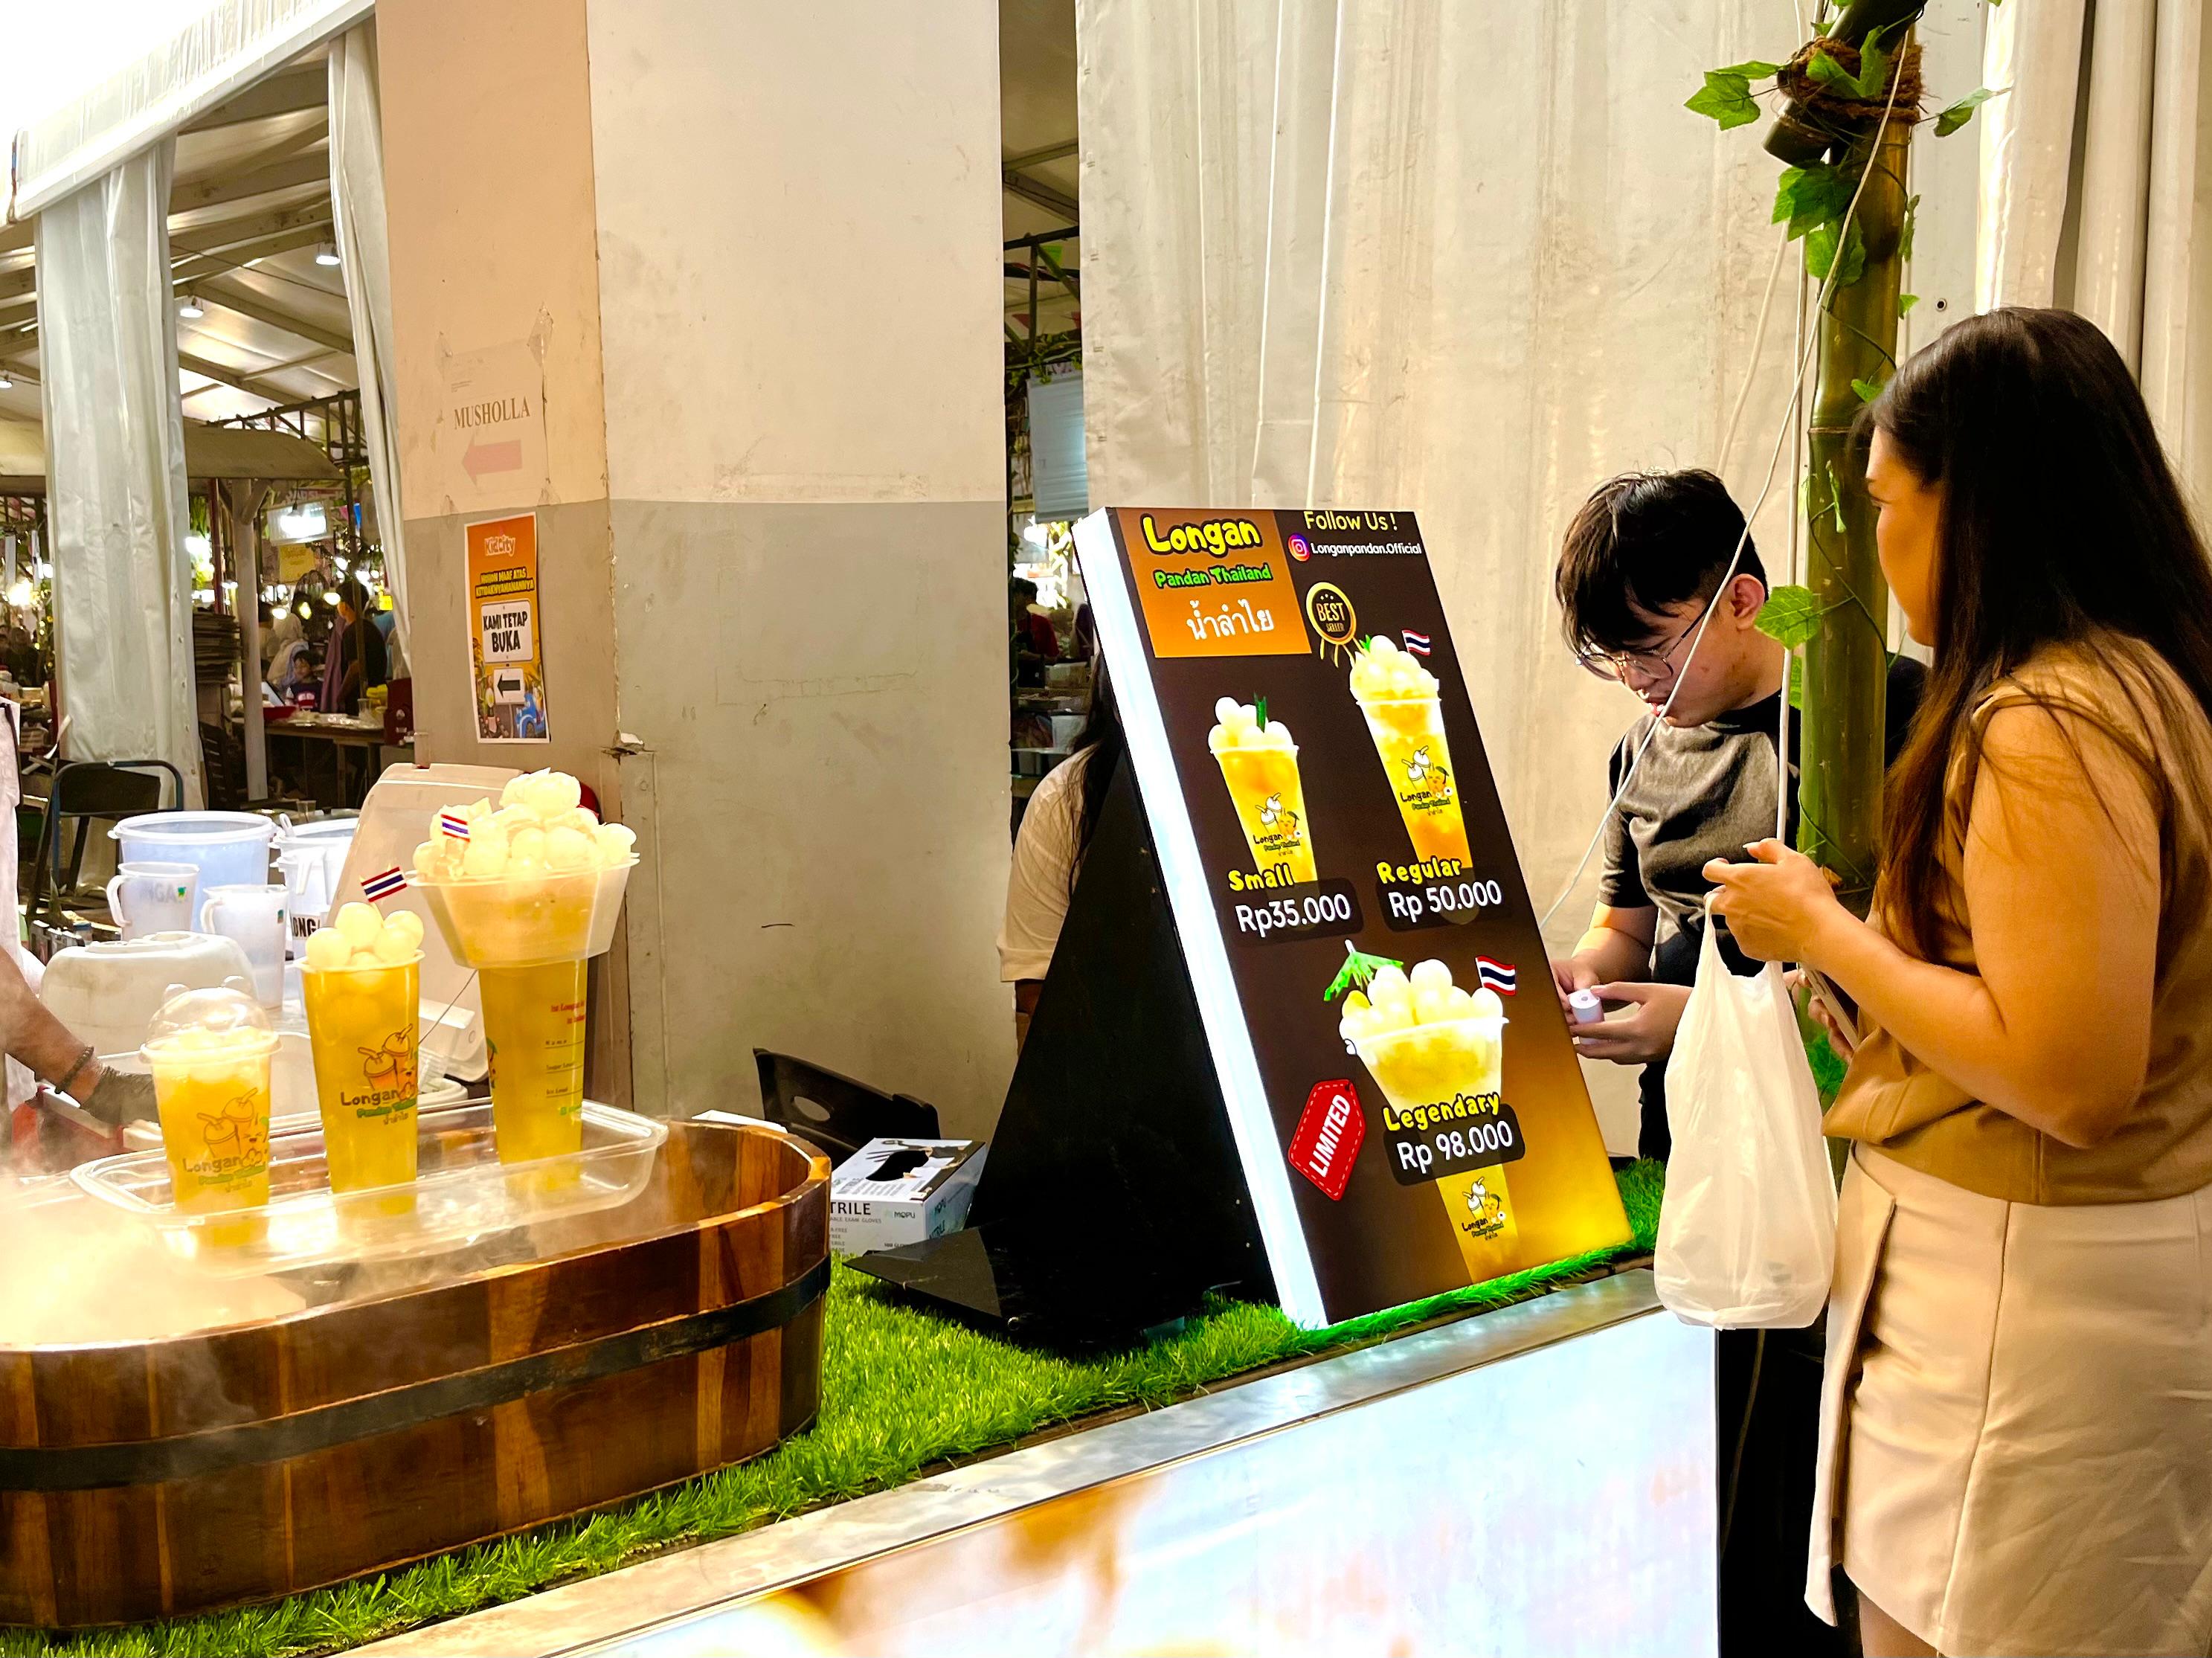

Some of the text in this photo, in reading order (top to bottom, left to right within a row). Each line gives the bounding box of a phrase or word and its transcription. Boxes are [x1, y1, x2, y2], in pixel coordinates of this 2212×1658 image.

[454, 396, 530, 429] MUSHOLLA
[1303, 510, 1360, 530] Follow
[1142, 515, 1261, 556] Longan
[1311, 542, 1422, 557] Longanpandan.Official
[1154, 563, 1273, 588] Pandan Thailand
[483, 611, 527, 631] KAMI TETAP
[1186, 598, 1274, 640] น้ำลำไย
[1316, 603, 1345, 622] BEST
[492, 630, 521, 653] BUKA
[1253, 834, 1283, 844] Longan
[1227, 864, 1294, 892] Small
[1376, 857, 1462, 886] Regular
[1389, 879, 1502, 925] Rp 50.000
[291, 917, 320, 937] ONG
[1235, 894, 1351, 938] Rp35.000
[341, 1090, 399, 1106] Longan
[1383, 1091, 1501, 1131] Legendary
[1309, 1094, 1351, 1177] LIMITED
[1396, 1121, 1513, 1174] Rp 98.000
[830, 1201, 871, 1215] TRILE
